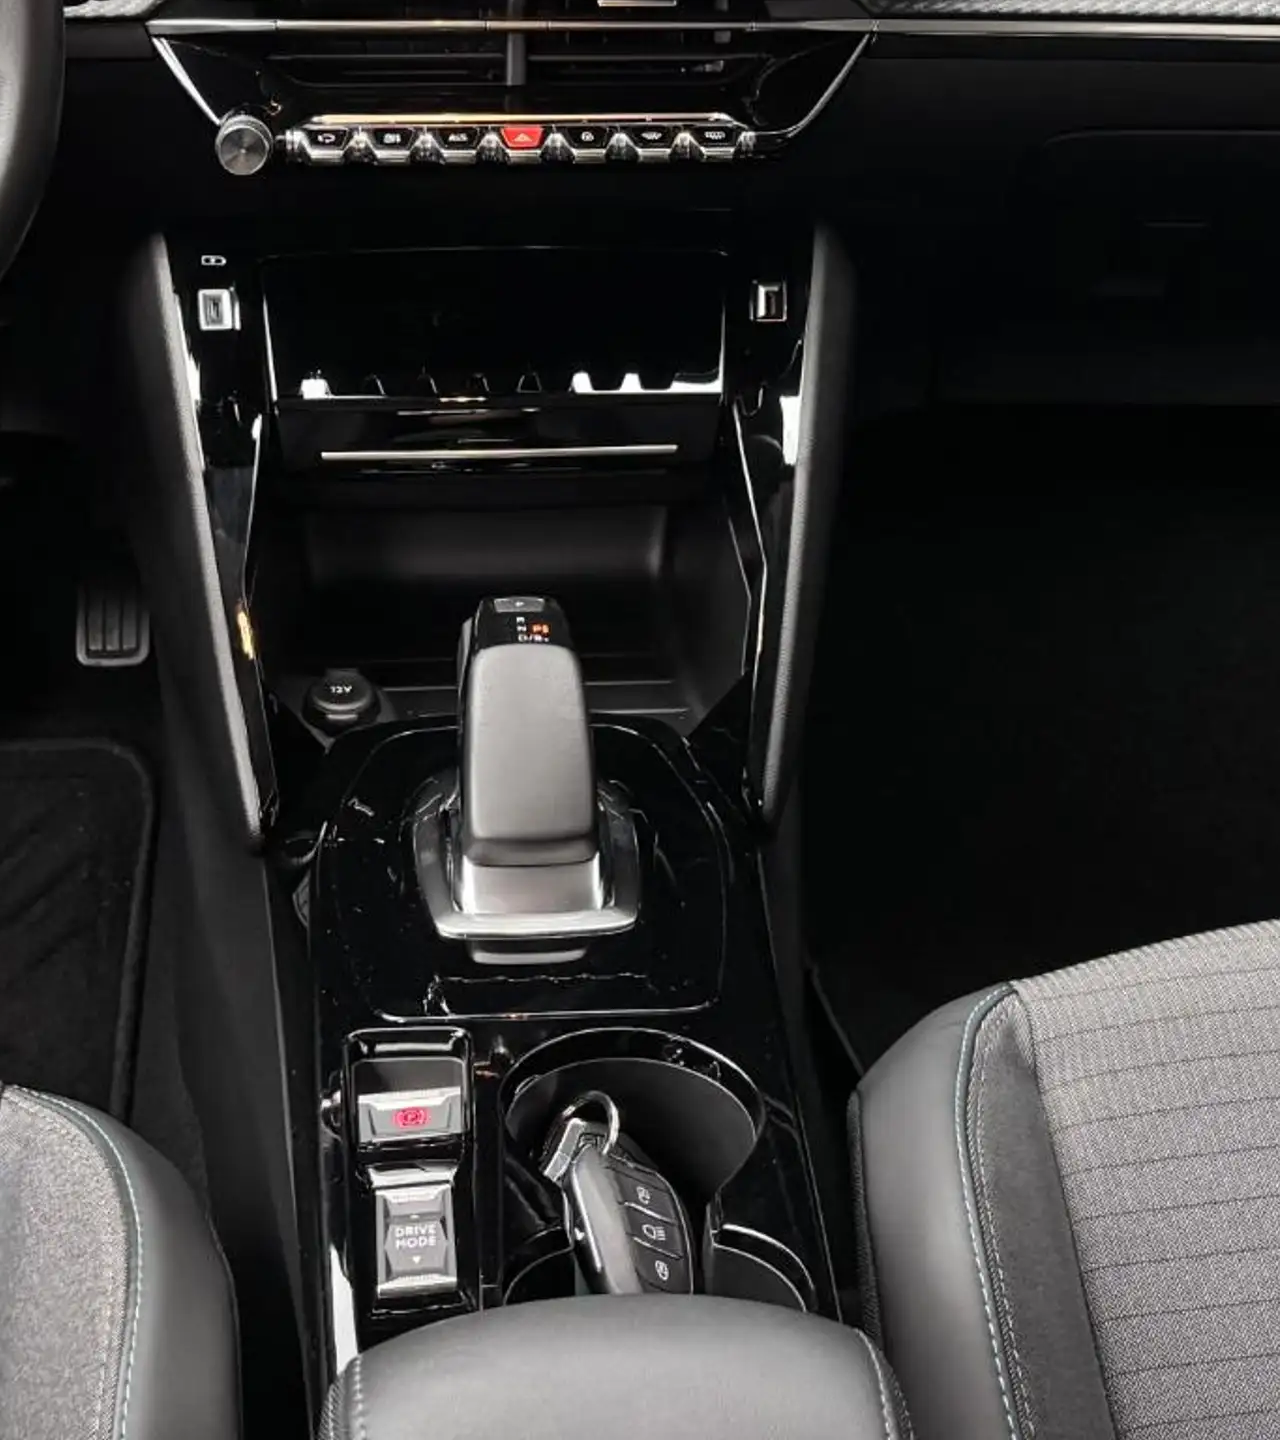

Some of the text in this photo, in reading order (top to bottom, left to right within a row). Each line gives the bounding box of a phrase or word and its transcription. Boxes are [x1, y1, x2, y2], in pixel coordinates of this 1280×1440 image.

[329, 685, 353, 694] 12V
[395, 1223, 436, 1237] DRIVE
[395, 1234, 437, 1249] MODE
